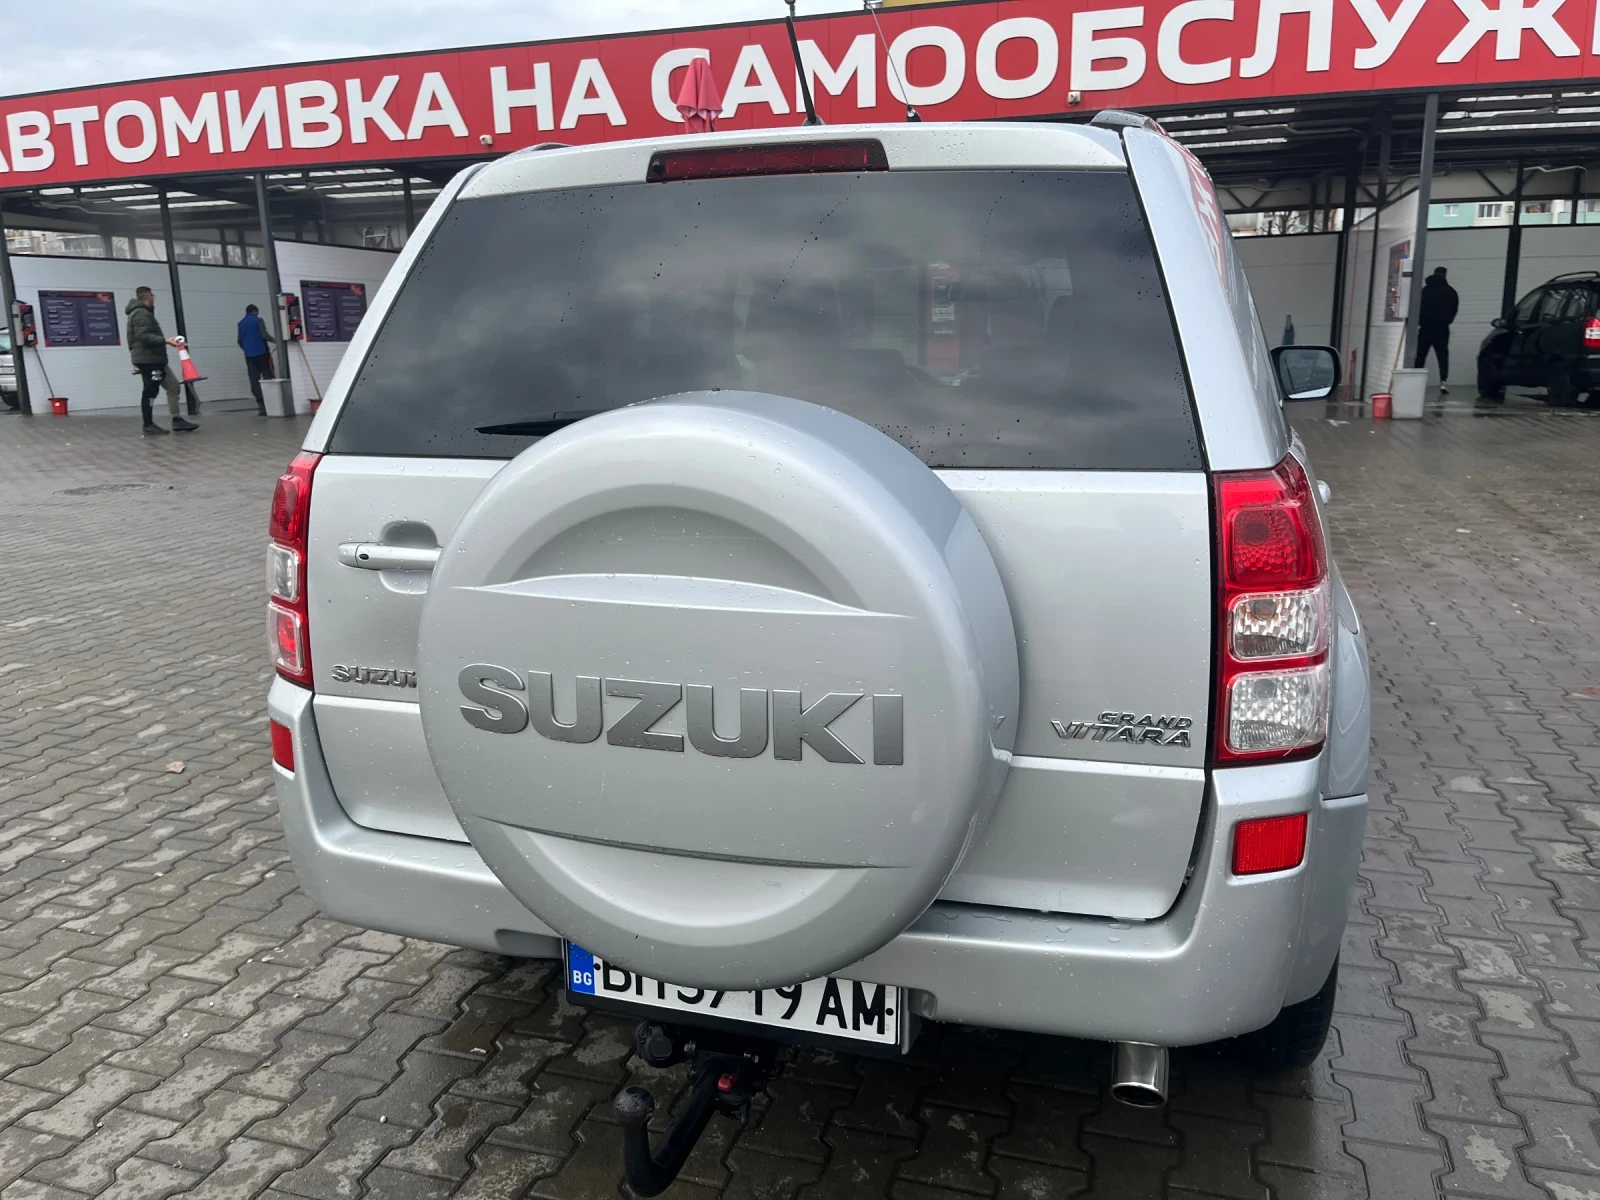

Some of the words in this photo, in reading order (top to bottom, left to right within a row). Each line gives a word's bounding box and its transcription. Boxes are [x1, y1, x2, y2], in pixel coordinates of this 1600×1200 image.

[0, 71, 469, 173] ВТОМИВКА
[490, 58, 628, 133] НА
[651, 0, 1600, 123] САМООБСЛУЖ
[458, 663, 903, 765] SUZUKI
[1050, 720, 1192, 747] VITARA
[1098, 710, 1193, 729] GRAND
[573, 970, 592, 986] BG
[815, 977, 886, 1035] AM
